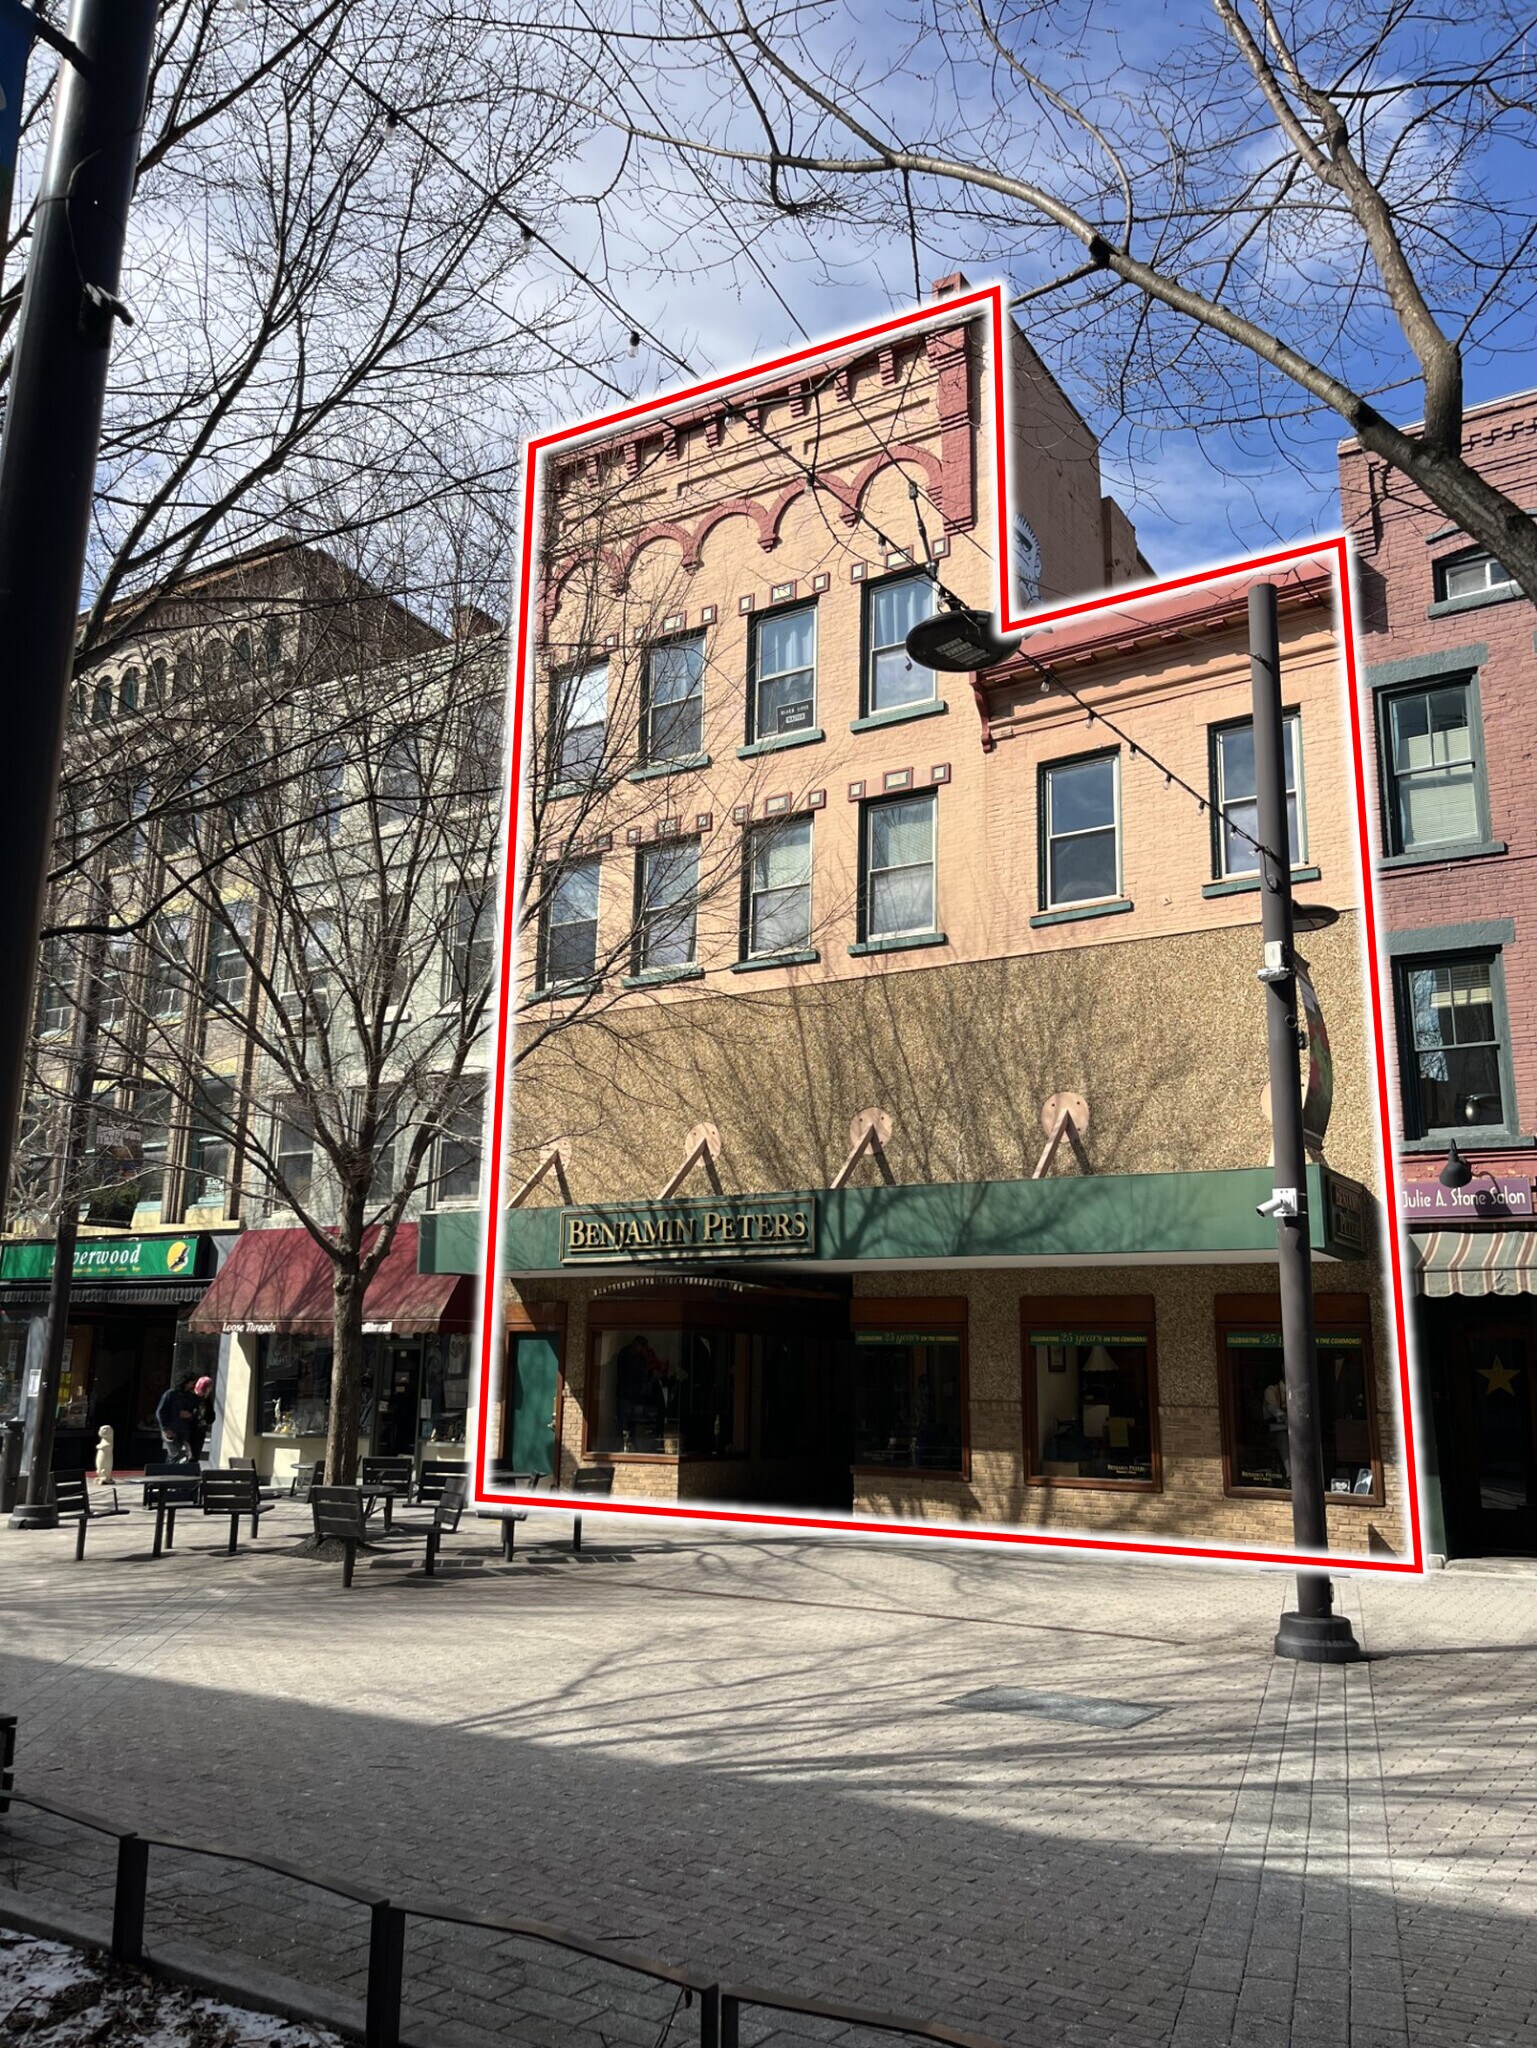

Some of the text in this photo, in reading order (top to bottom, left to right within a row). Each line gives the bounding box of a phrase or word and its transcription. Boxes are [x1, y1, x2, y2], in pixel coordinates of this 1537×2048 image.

[1402, 1185, 1526, 1208] Julie A. Stone Salon
[568, 1212, 807, 1252] BENJAMIN PETERS
[222, 1322, 276, 1332] Loose Threads
[1061, 1332, 1073, 1342] 25
[1075, 1333, 1102, 1345] years
[1263, 1333, 1276, 1344] 25
